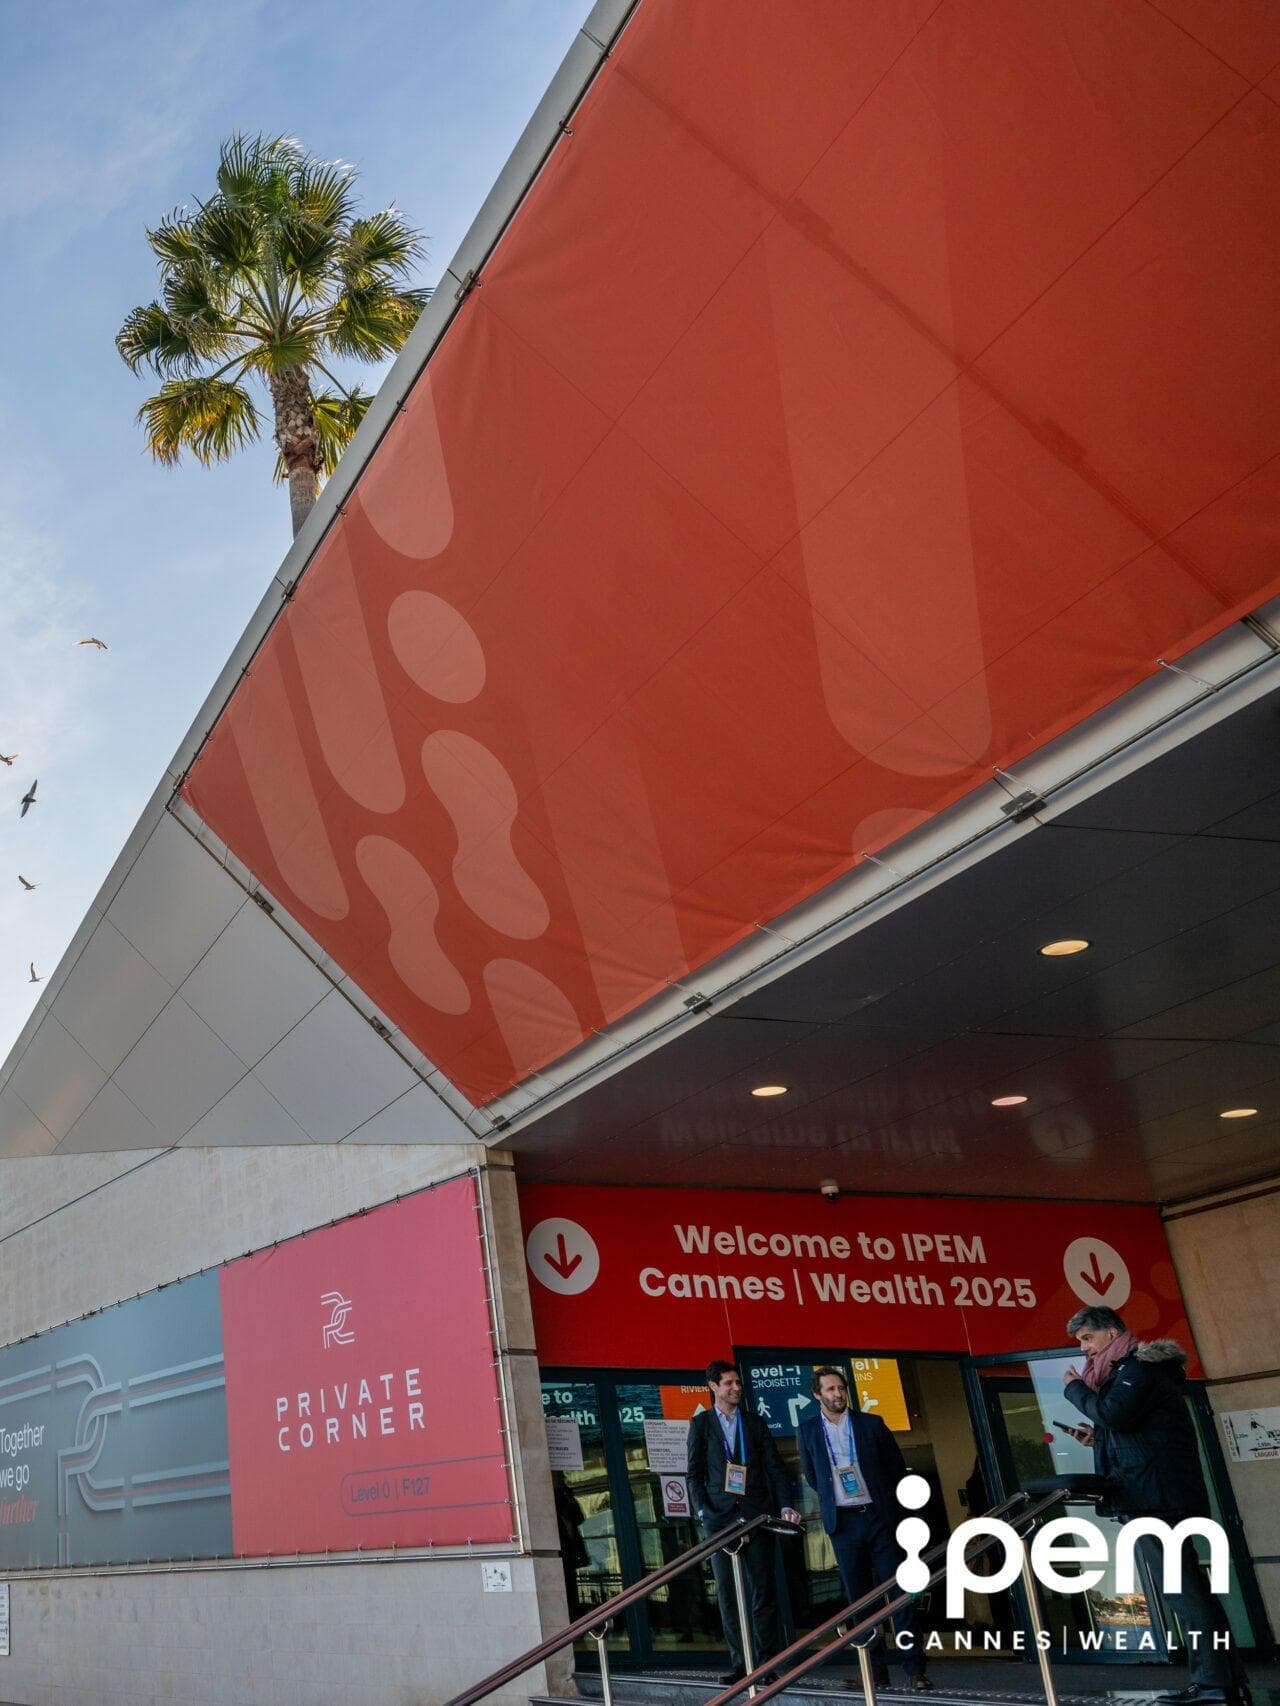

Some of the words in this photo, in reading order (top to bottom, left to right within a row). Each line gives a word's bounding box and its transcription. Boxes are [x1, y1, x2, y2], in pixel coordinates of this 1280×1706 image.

[673, 1224, 851, 1259] Welcome
[857, 1231, 896, 1261] to
[901, 1233, 987, 1264] IPEM
[639, 1267, 785, 1301] Cannes
[809, 1272, 945, 1306] Wealth
[950, 1276, 1037, 1308] 2025
[751, 1365, 783, 1378] evel
[276, 1367, 422, 1422] PRIVATE
[553, 1389, 573, 1404] to
[278, 1401, 425, 1452] CORNER
[15, 1464, 30, 1492] go
[349, 1481, 380, 1503] Level
[402, 1475, 431, 1497] F127
